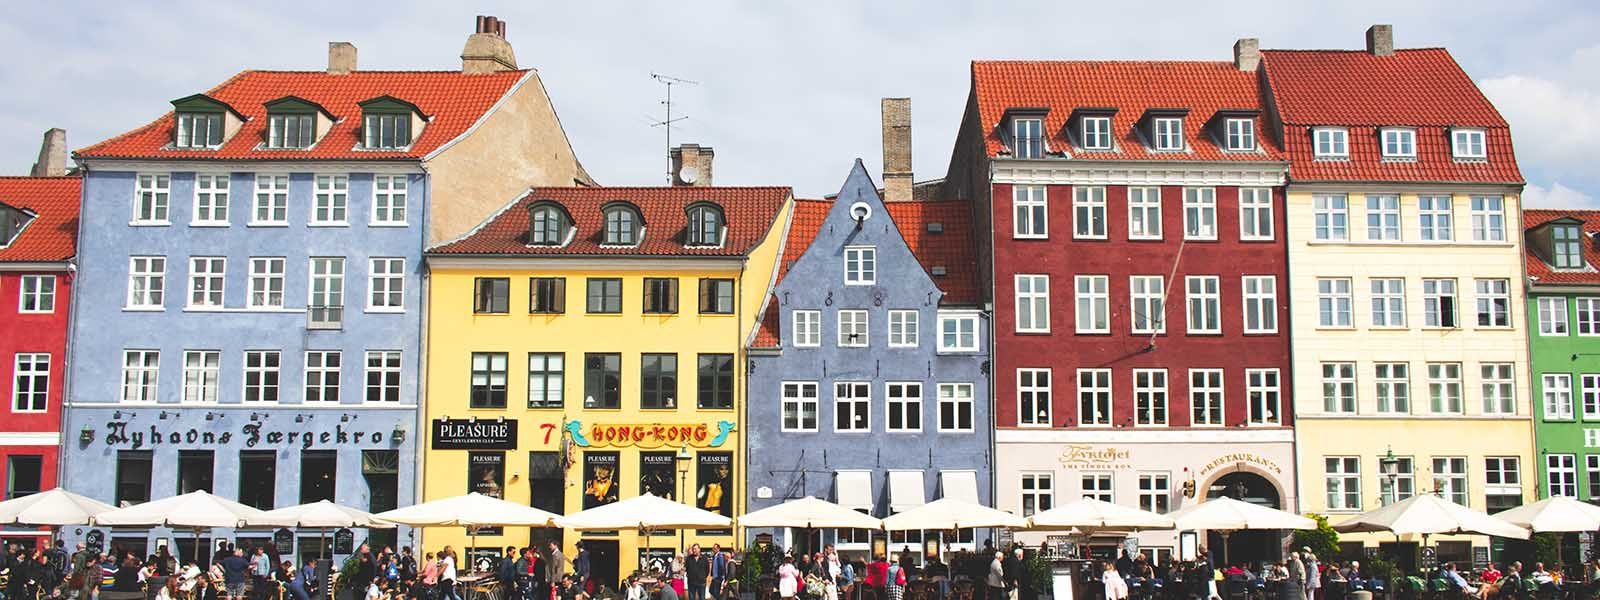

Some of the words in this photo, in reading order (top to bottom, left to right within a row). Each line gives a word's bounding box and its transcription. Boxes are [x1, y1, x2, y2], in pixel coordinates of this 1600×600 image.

[106, 422, 232, 449] Nyhavns
[243, 421, 383, 449] Færgekro
[440, 424, 508, 438] PLEASURE
[540, 423, 556, 445] 7
[592, 426, 707, 441] HONG-KONG
